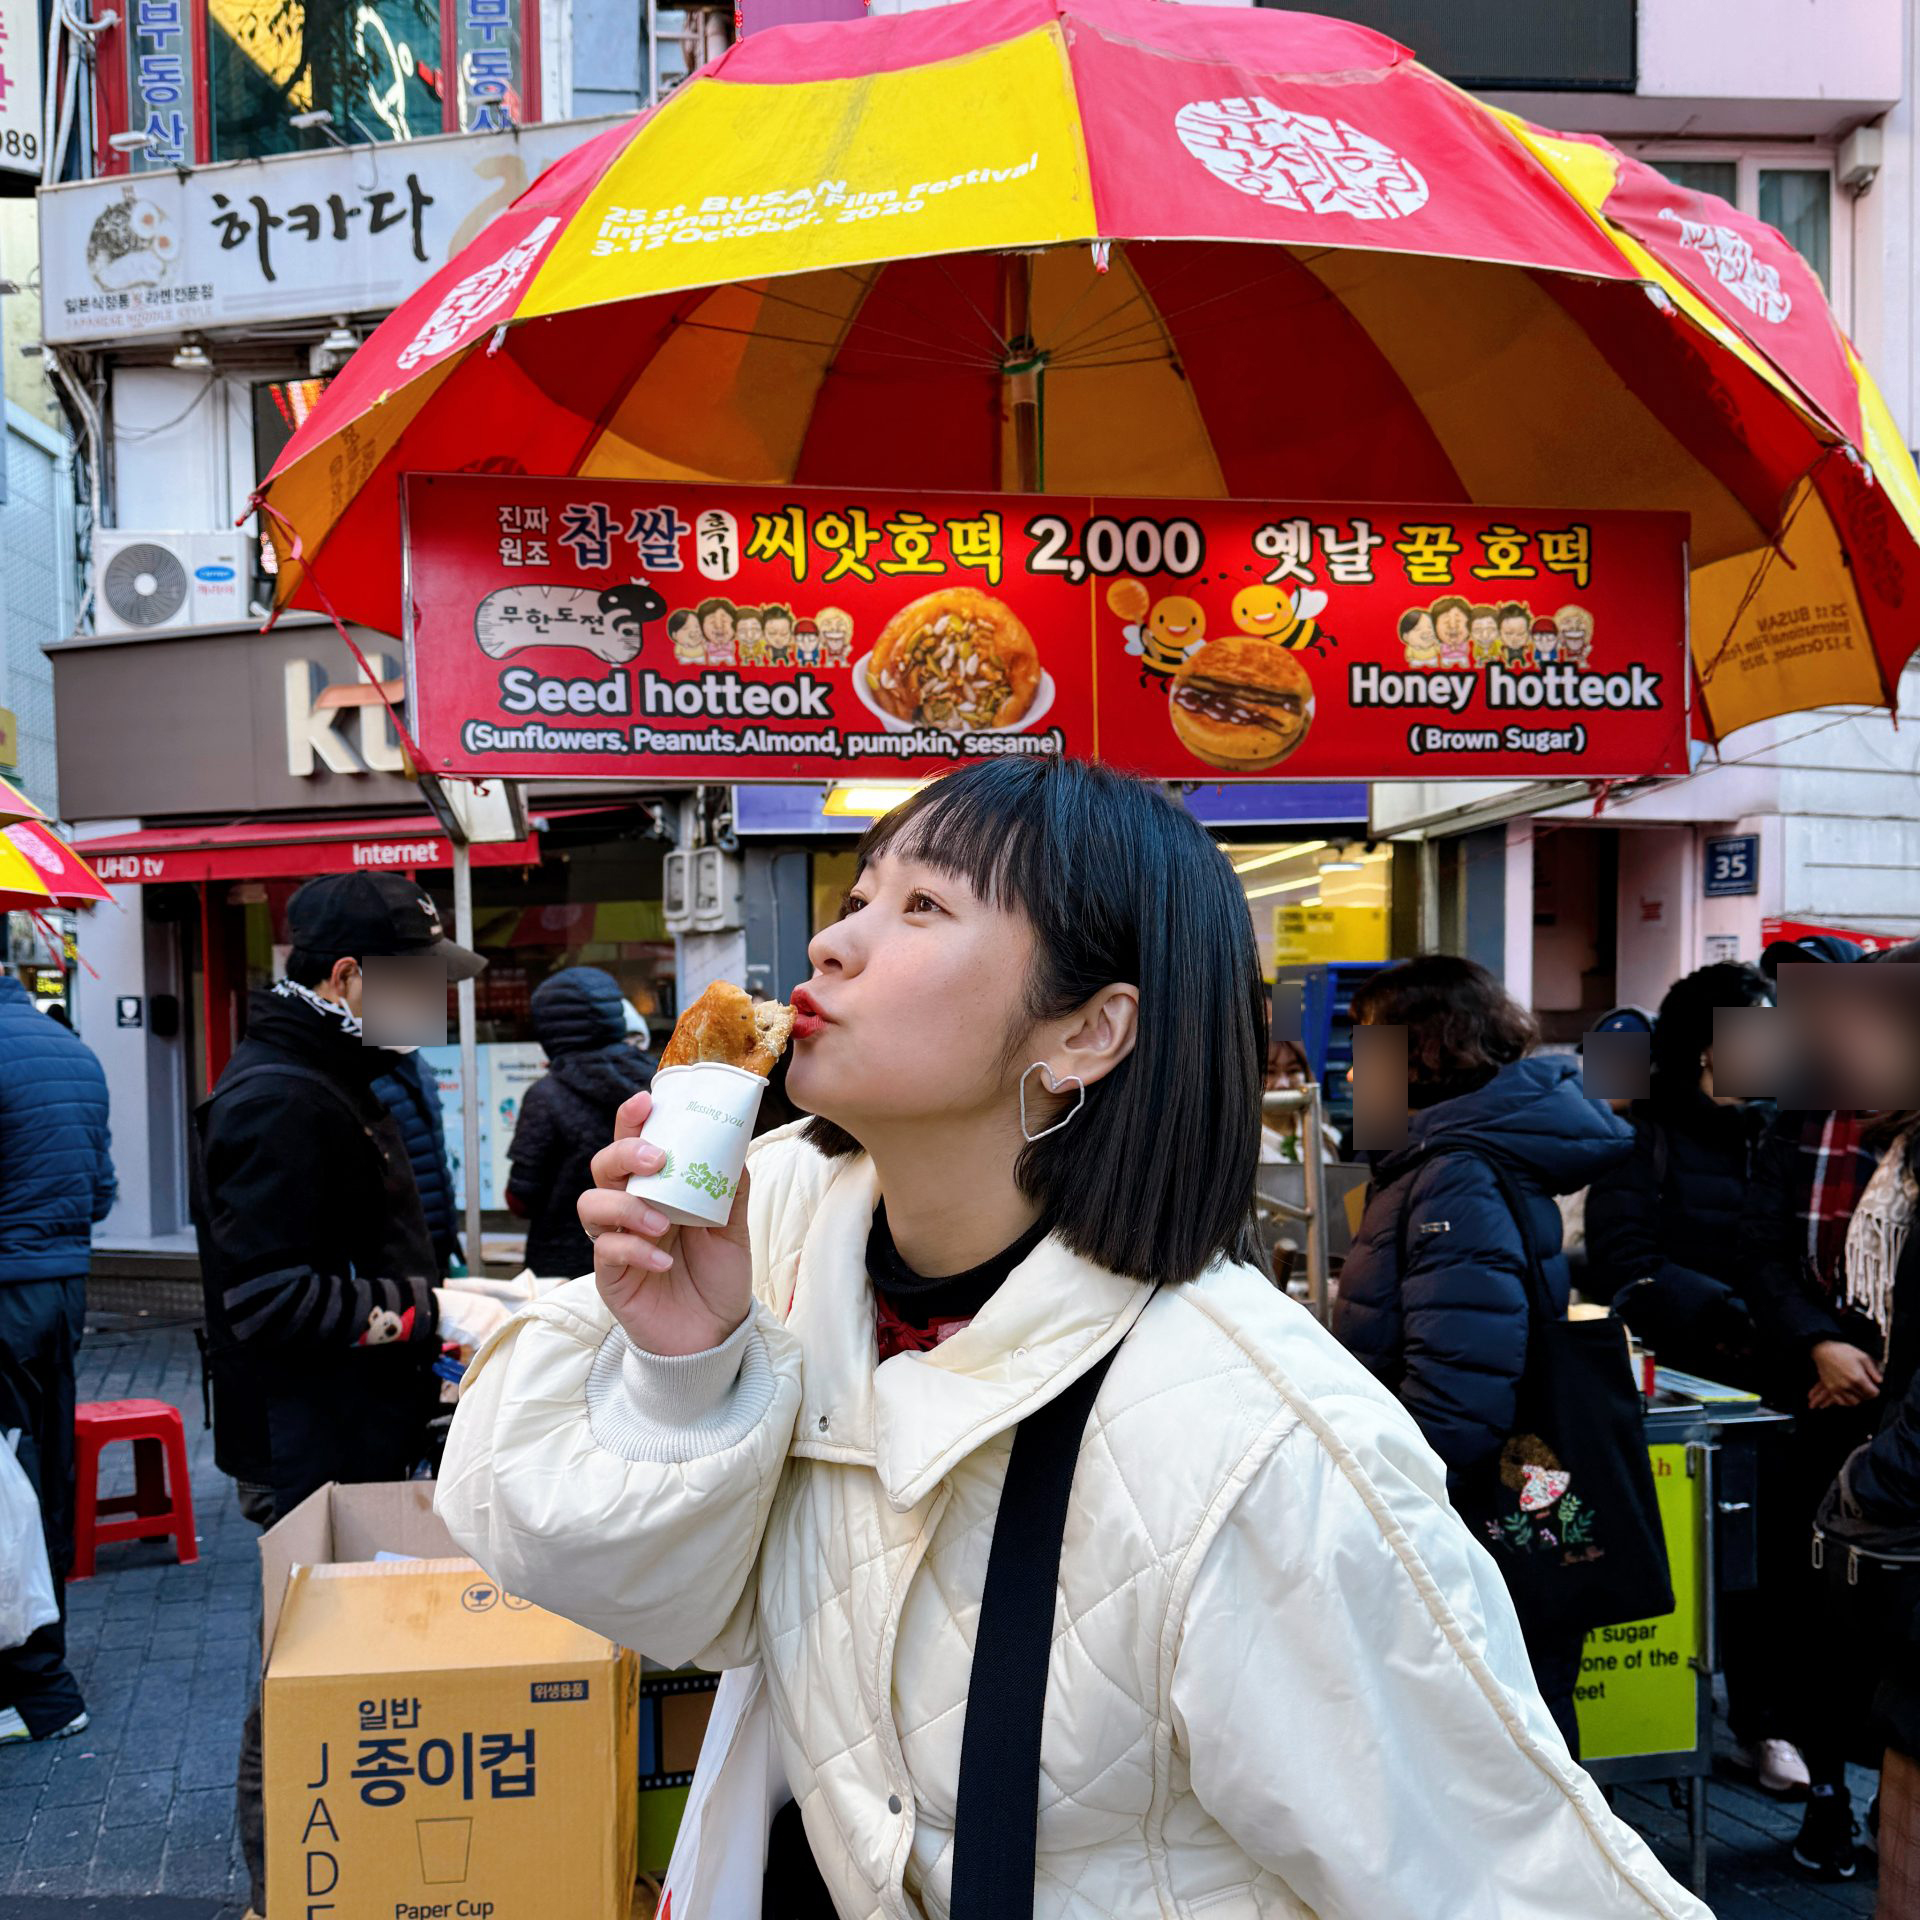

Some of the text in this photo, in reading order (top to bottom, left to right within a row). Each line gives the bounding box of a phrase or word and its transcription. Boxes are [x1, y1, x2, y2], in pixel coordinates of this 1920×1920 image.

[137, 0, 187, 161] 부동산
[0, 129, 37, 160] 89
[597, 152, 1039, 239] International Film Festival
[604, 180, 847, 223] 25 st BUSAN
[836, 199, 925, 223] 2020
[211, 173, 434, 282] 하카다
[498, 506, 549, 534] 진짜
[498, 537, 550, 567] 원조
[558, 502, 1201, 585] 찹쌀 흑미 씨앗호떡 2,000
[1254, 519, 1384, 585] 옛날
[499, 605, 605, 635] 무한도전
[502, 669, 830, 716] Seed hotteok
[1351, 664, 1659, 711] Honey hotteok
[285, 653, 405, 777] kt
[847, 731, 959, 758] pumpkin,
[963, 730, 1063, 756] sesame)
[1505, 726, 1586, 753] Sugar)
[97, 856, 165, 879] UHD tv
[352, 841, 440, 866] Internet
[1714, 853, 1747, 880] 35
[685, 1101, 745, 1128] Blessing you
[1602, 1625, 1658, 1644] sugar
[1624, 1650, 1643, 1669] of
[1649, 1648, 1679, 1667] the
[534, 1682, 584, 1701] 위생용품
[1574, 1681, 1606, 1701] eet
[357, 1697, 422, 1731] 일반
[350, 1728, 536, 1807] 종이컵
[395, 1900, 494, 1920] Paper Cup
